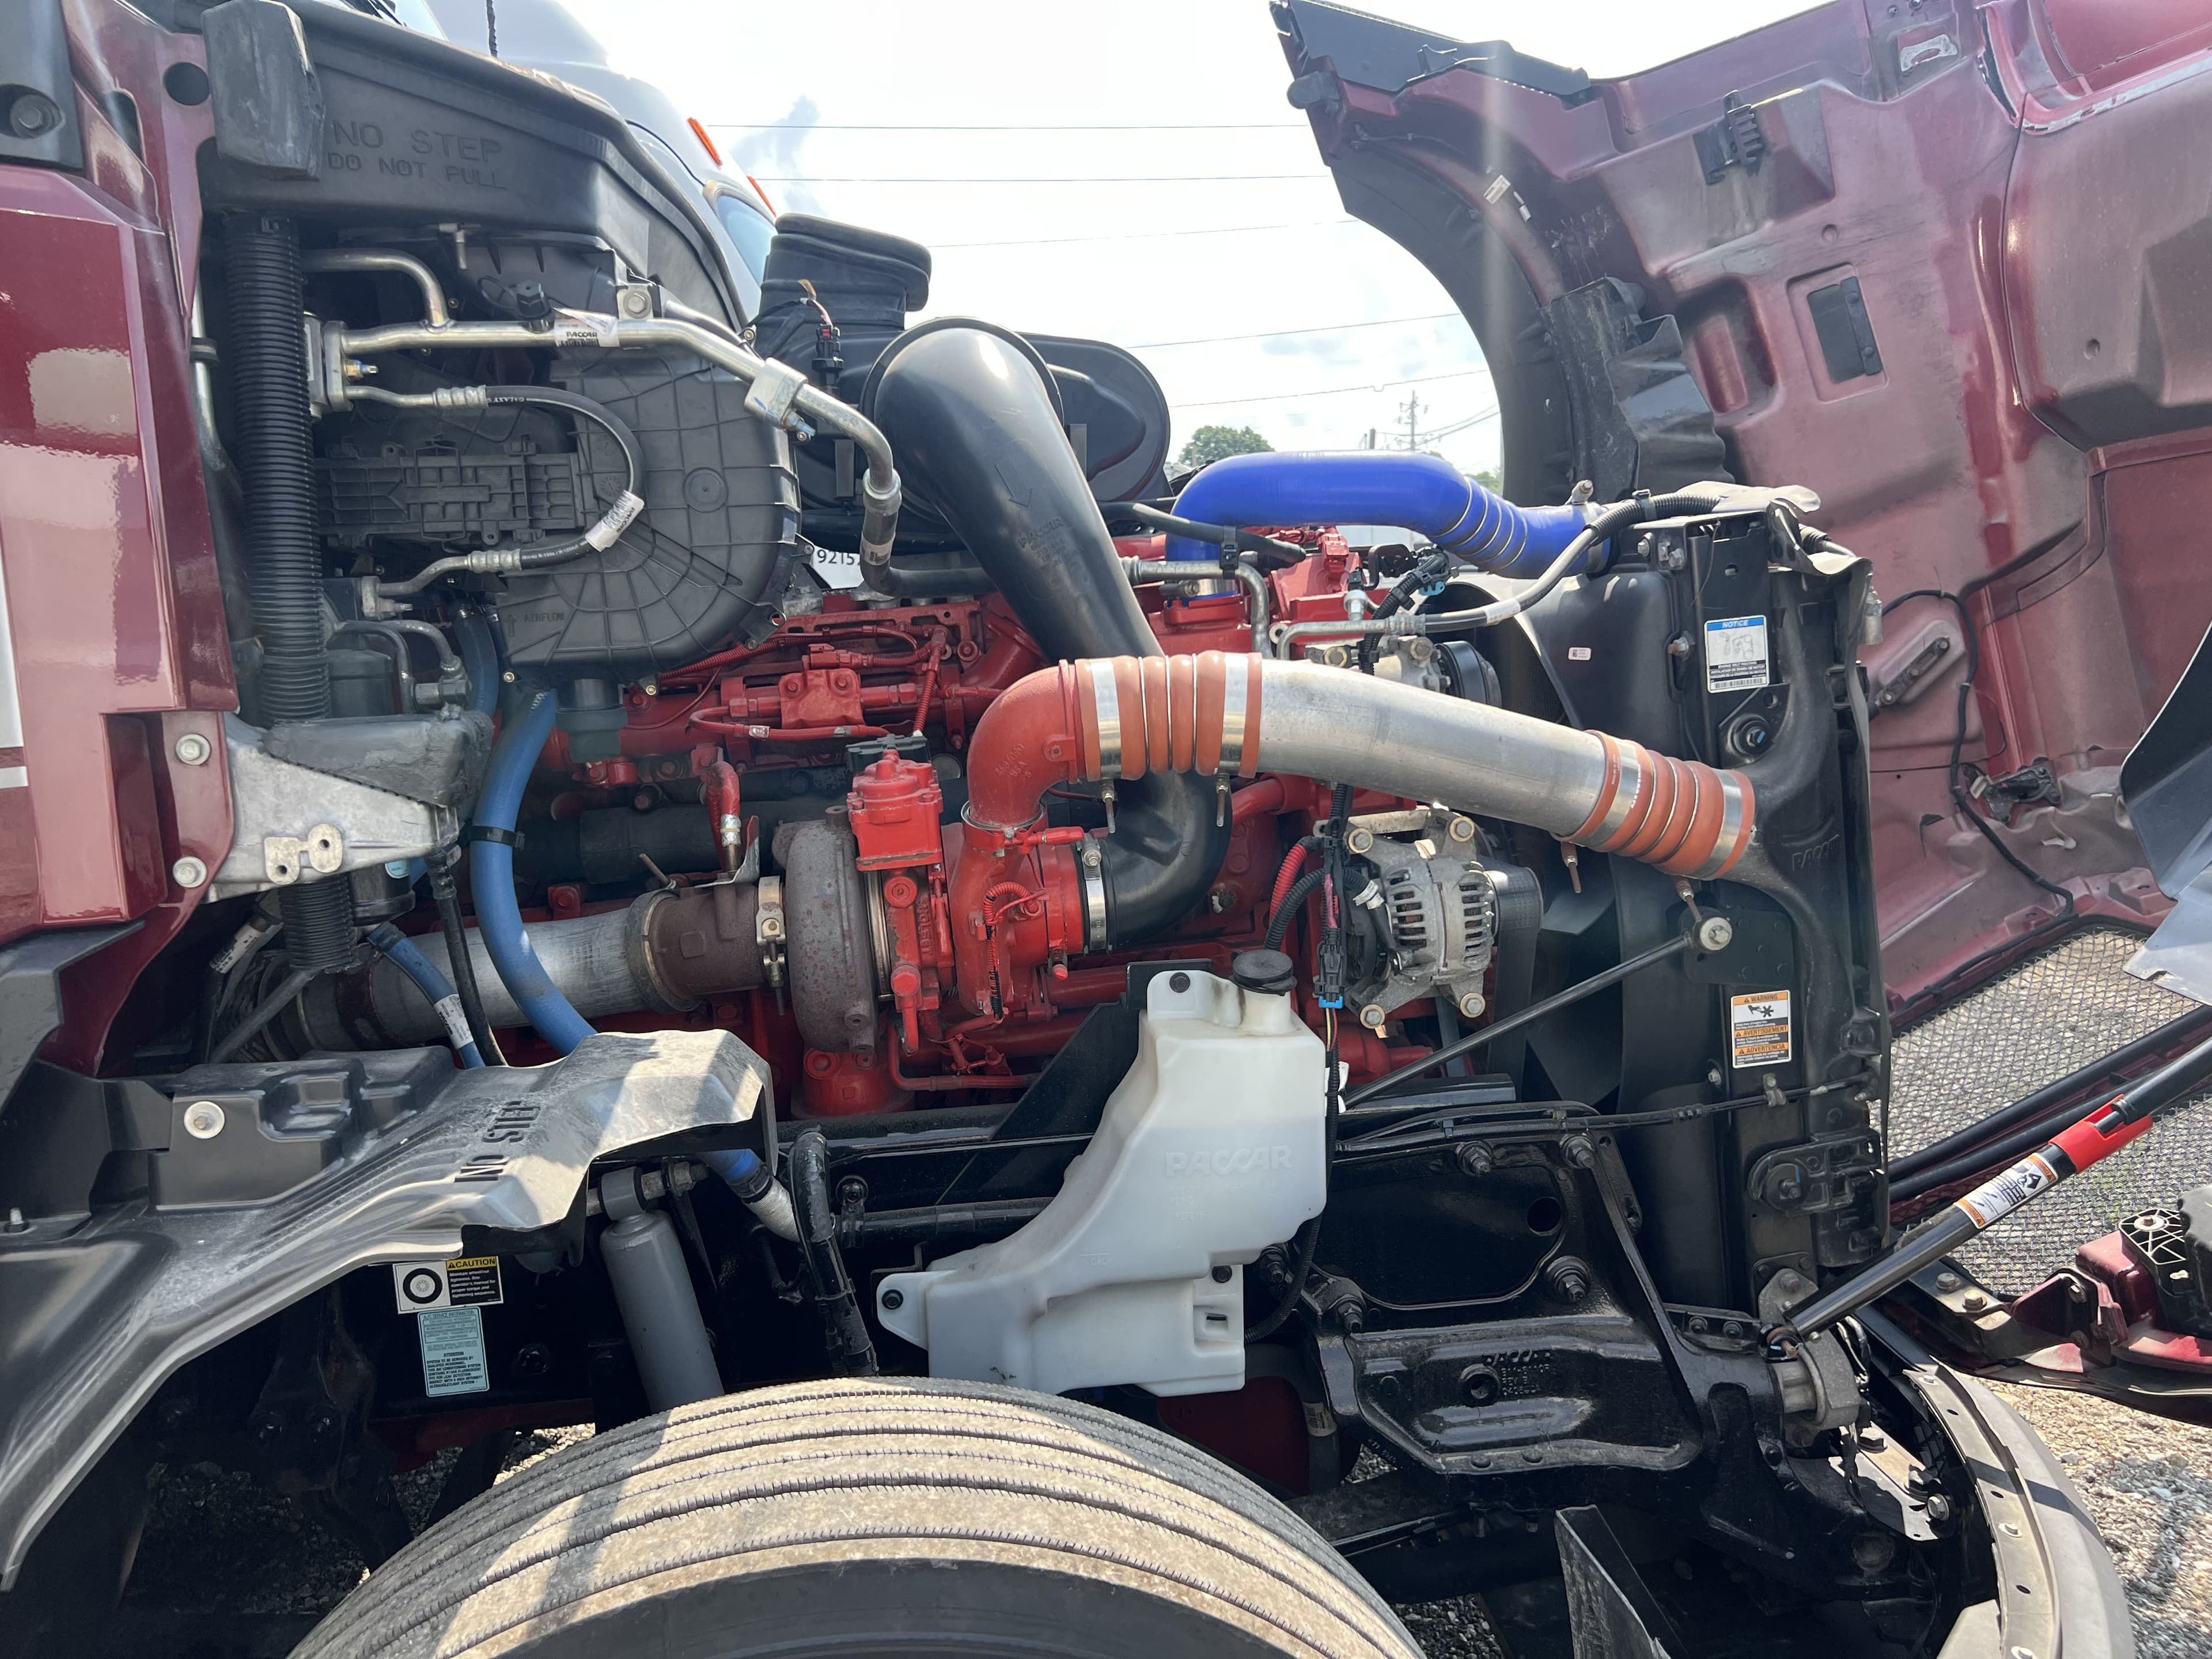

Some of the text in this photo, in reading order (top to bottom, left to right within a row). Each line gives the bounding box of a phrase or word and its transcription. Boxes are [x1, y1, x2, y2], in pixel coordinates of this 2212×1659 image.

[333, 119, 502, 162] NO STEP
[328, 151, 507, 190] DO NOT PULL
[817, 549, 860, 566] 9215
[524, 612, 564, 623] AIRFLOW
[1722, 620, 1749, 628] NOTICE
[1751, 994, 1778, 1002] WARNING
[1743, 1026, 1787, 1036] AVERTISSEMENT
[1747, 1044, 1785, 1054] ADVERTENCIA
[482, 1101, 540, 1143] STEP
[454, 1154, 509, 1183] NO
[1165, 1146, 1293, 1177] PACCAR
[456, 1258, 495, 1268] CAUTION
